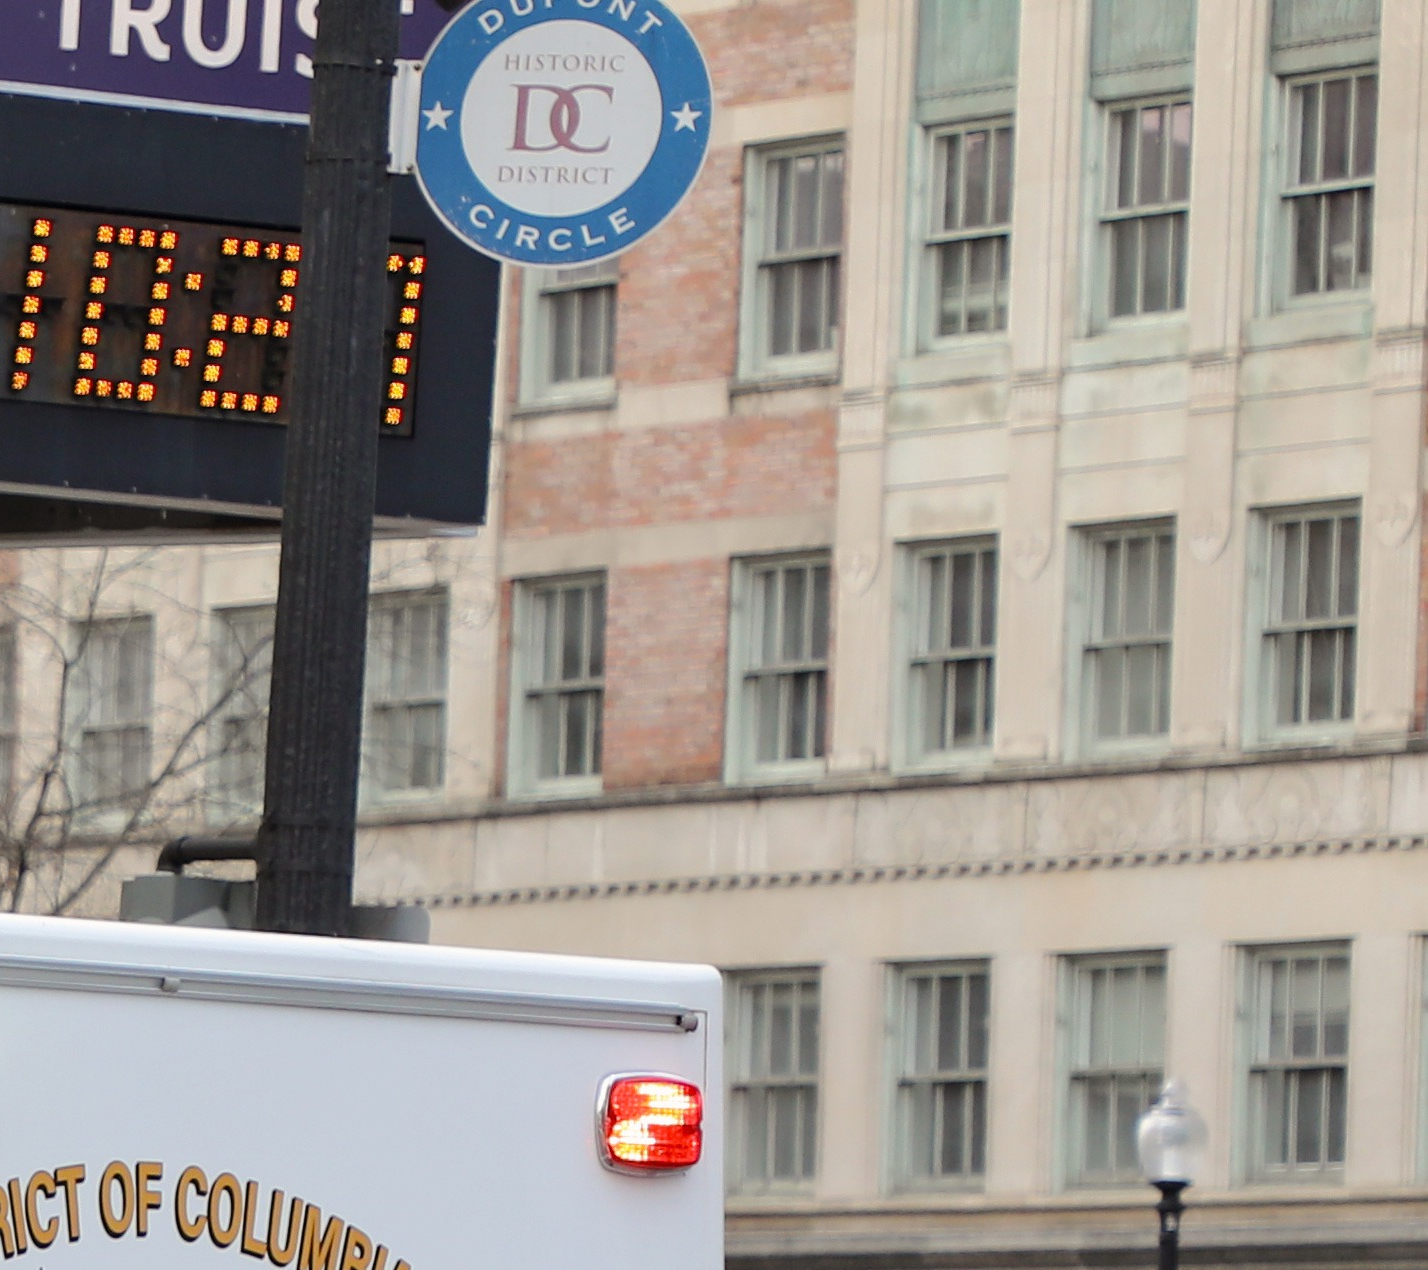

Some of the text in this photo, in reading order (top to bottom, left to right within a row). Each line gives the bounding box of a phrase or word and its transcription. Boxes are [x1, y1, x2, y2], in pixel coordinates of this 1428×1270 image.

[59, 0, 414, 79] RUI
[504, 54, 625, 73] HISTORIC
[506, 83, 615, 154] DC
[497, 165, 614, 185] DISTRICT
[469, 207, 636, 251] CIRCLE
[98, 1160, 163, 1238] OF
